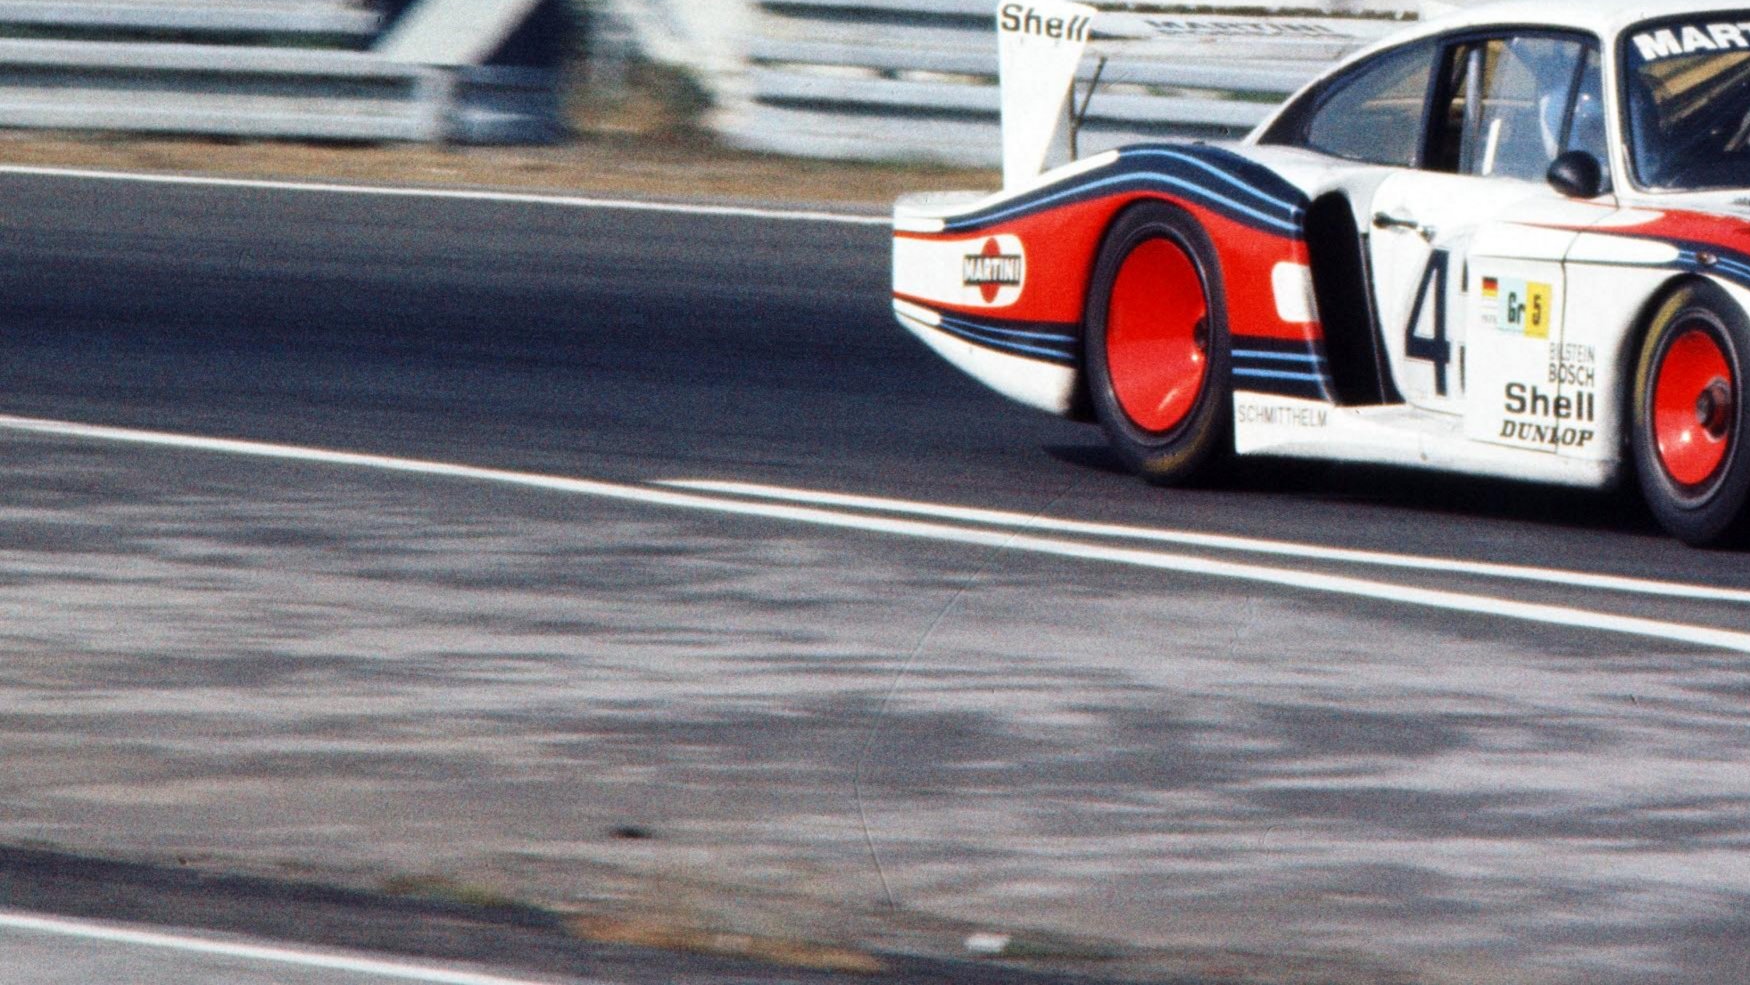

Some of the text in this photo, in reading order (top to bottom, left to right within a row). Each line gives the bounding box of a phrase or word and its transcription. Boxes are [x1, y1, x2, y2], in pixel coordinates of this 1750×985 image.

[1001, 3, 1090, 42] Shell
[963, 256, 1021, 283] MARTINI
[1507, 290, 1542, 327] Gr 5
[1548, 341, 1596, 364] BILSTEIN
[1548, 362, 1595, 387] BOSCH
[1504, 381, 1595, 422] Shell
[1499, 418, 1595, 447] DUNLOP
